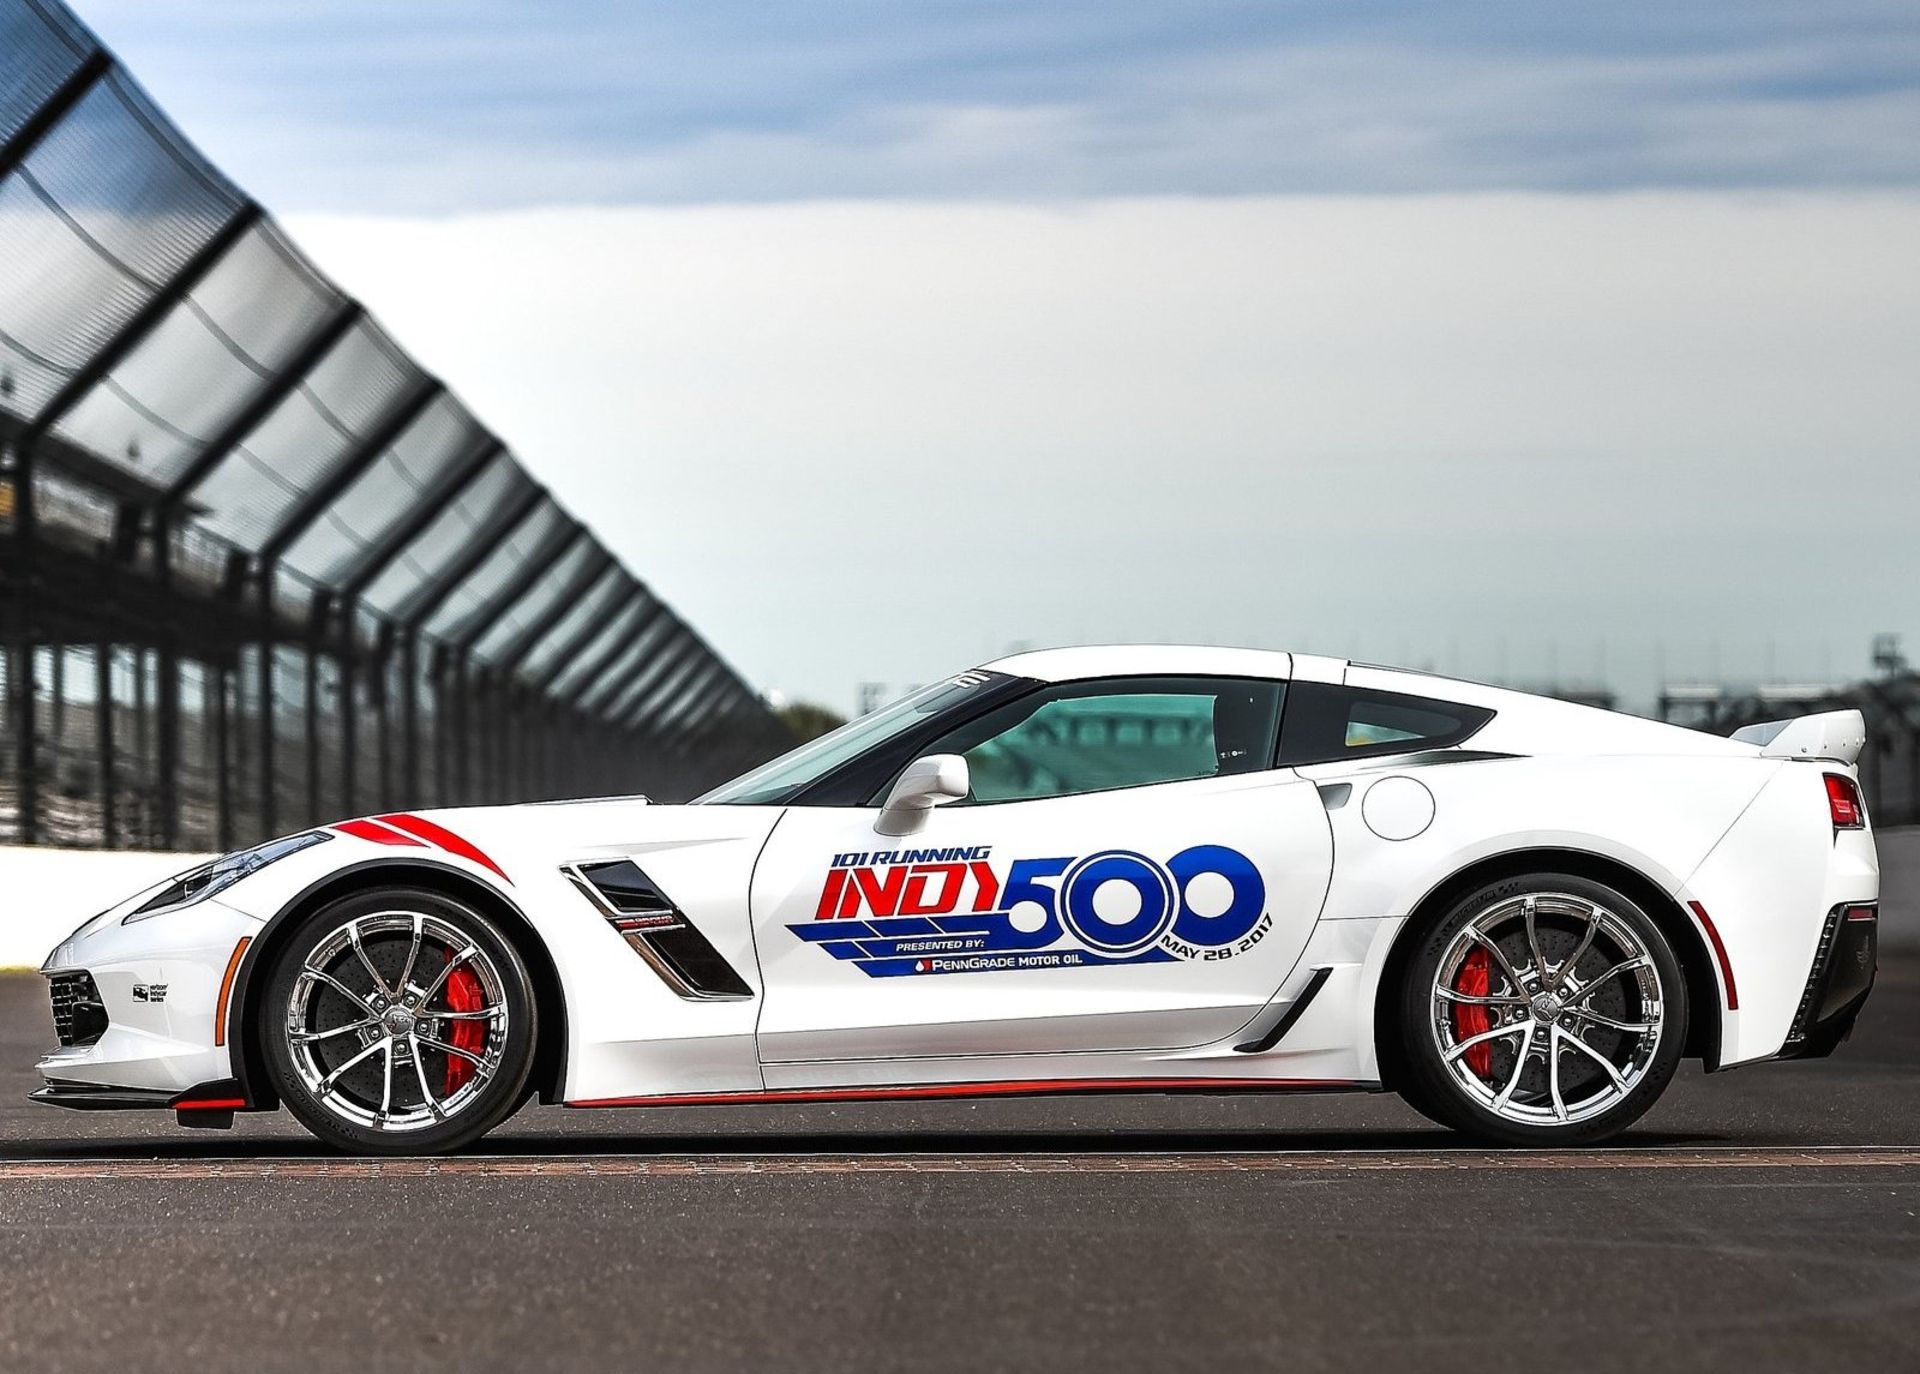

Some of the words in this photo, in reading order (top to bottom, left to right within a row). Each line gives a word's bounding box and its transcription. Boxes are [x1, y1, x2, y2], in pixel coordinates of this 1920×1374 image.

[831, 852, 869, 867] 101
[869, 846, 993, 866] RUNNING
[998, 844, 1266, 953] 500
[896, 940, 962, 951] PRESENTED
[965, 940, 985, 949] BY:
[1160, 934, 1200, 959] MAY
[1018, 956, 1060, 967] MOTOR
[1063, 954, 1083, 964] OIL
